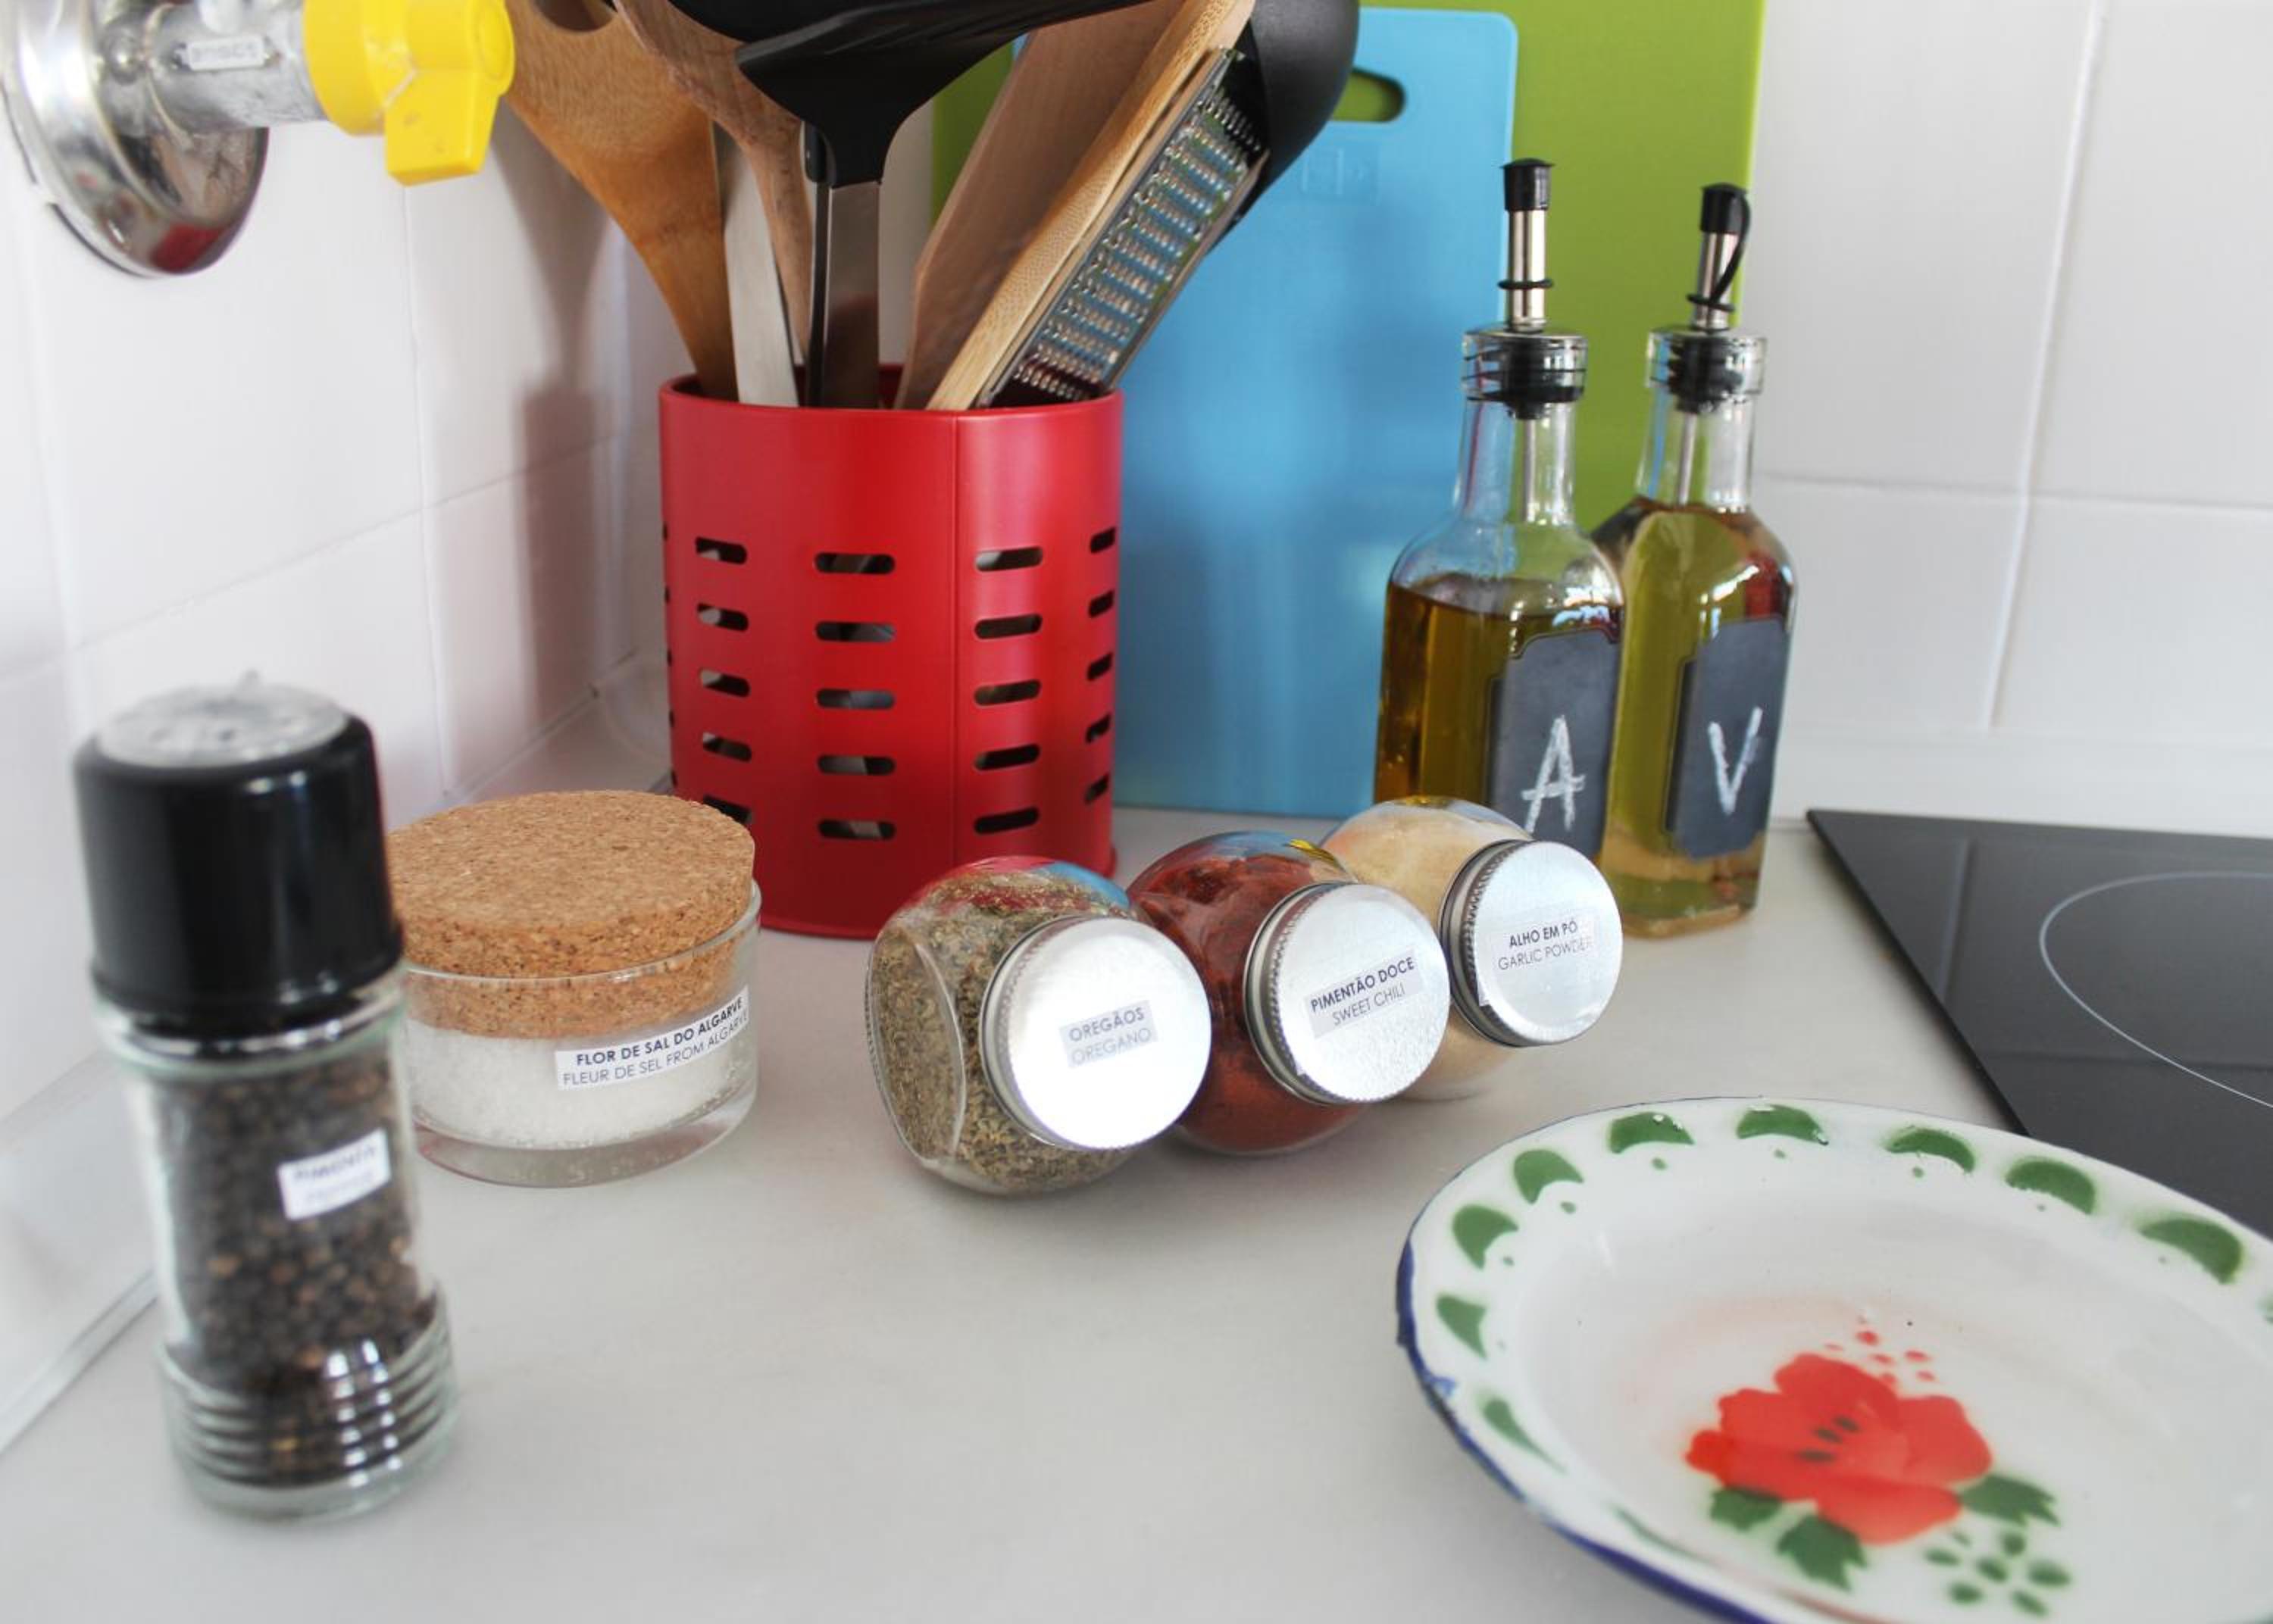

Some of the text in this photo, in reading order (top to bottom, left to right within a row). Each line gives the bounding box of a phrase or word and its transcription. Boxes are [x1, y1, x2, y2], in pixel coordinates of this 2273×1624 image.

[1521, 714, 1586, 833] A
[1708, 707, 1763, 816] V
[1509, 917, 1577, 948] ALHO EM PÓ
[1498, 948, 1543, 970] GARLIC
[1311, 957, 1415, 1013] PIMENTÃO DOCE
[1332, 982, 1405, 1026] SWEET CHILI
[577, 996, 743, 1066] FLOR DE SAL DO ALGARVE
[1069, 1006, 1145, 1042] OREGÃOS
[563, 1069, 609, 1085] FLEUR
[614, 1063, 635, 1079] DE
[639, 1059, 663, 1074] SEL
[666, 1042, 704, 1066] FROM
[1071, 1027, 1152, 1065] OREGANO
